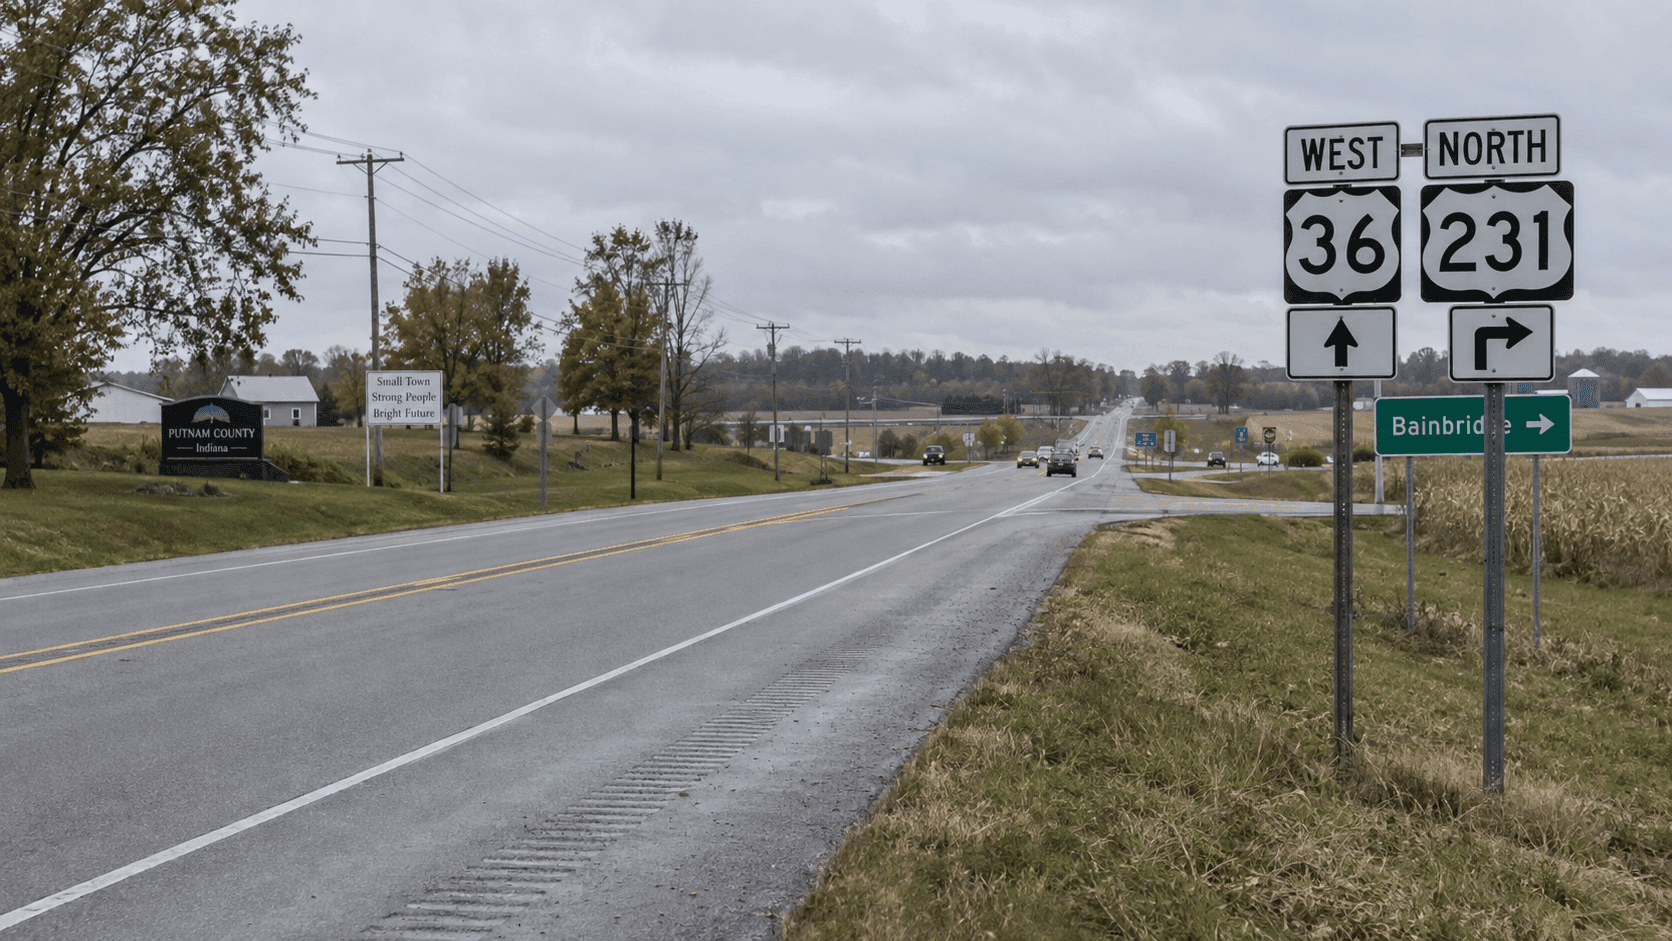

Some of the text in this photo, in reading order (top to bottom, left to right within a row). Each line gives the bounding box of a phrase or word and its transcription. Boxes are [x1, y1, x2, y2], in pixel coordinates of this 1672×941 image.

[1301, 136, 1383, 171] WEST
[1439, 129, 1546, 166] NORTH
[1298, 213, 1385, 275] 36
[1439, 210, 1549, 272] 231
[377, 376, 430, 386] Small Town
[372, 391, 436, 404] Strong People
[373, 408, 435, 420] Bright Future
[168, 428, 255, 438] PUTNAM COUNTY
[1392, 415, 1512, 436] Bainbride
[196, 442, 228, 453] Indiana
